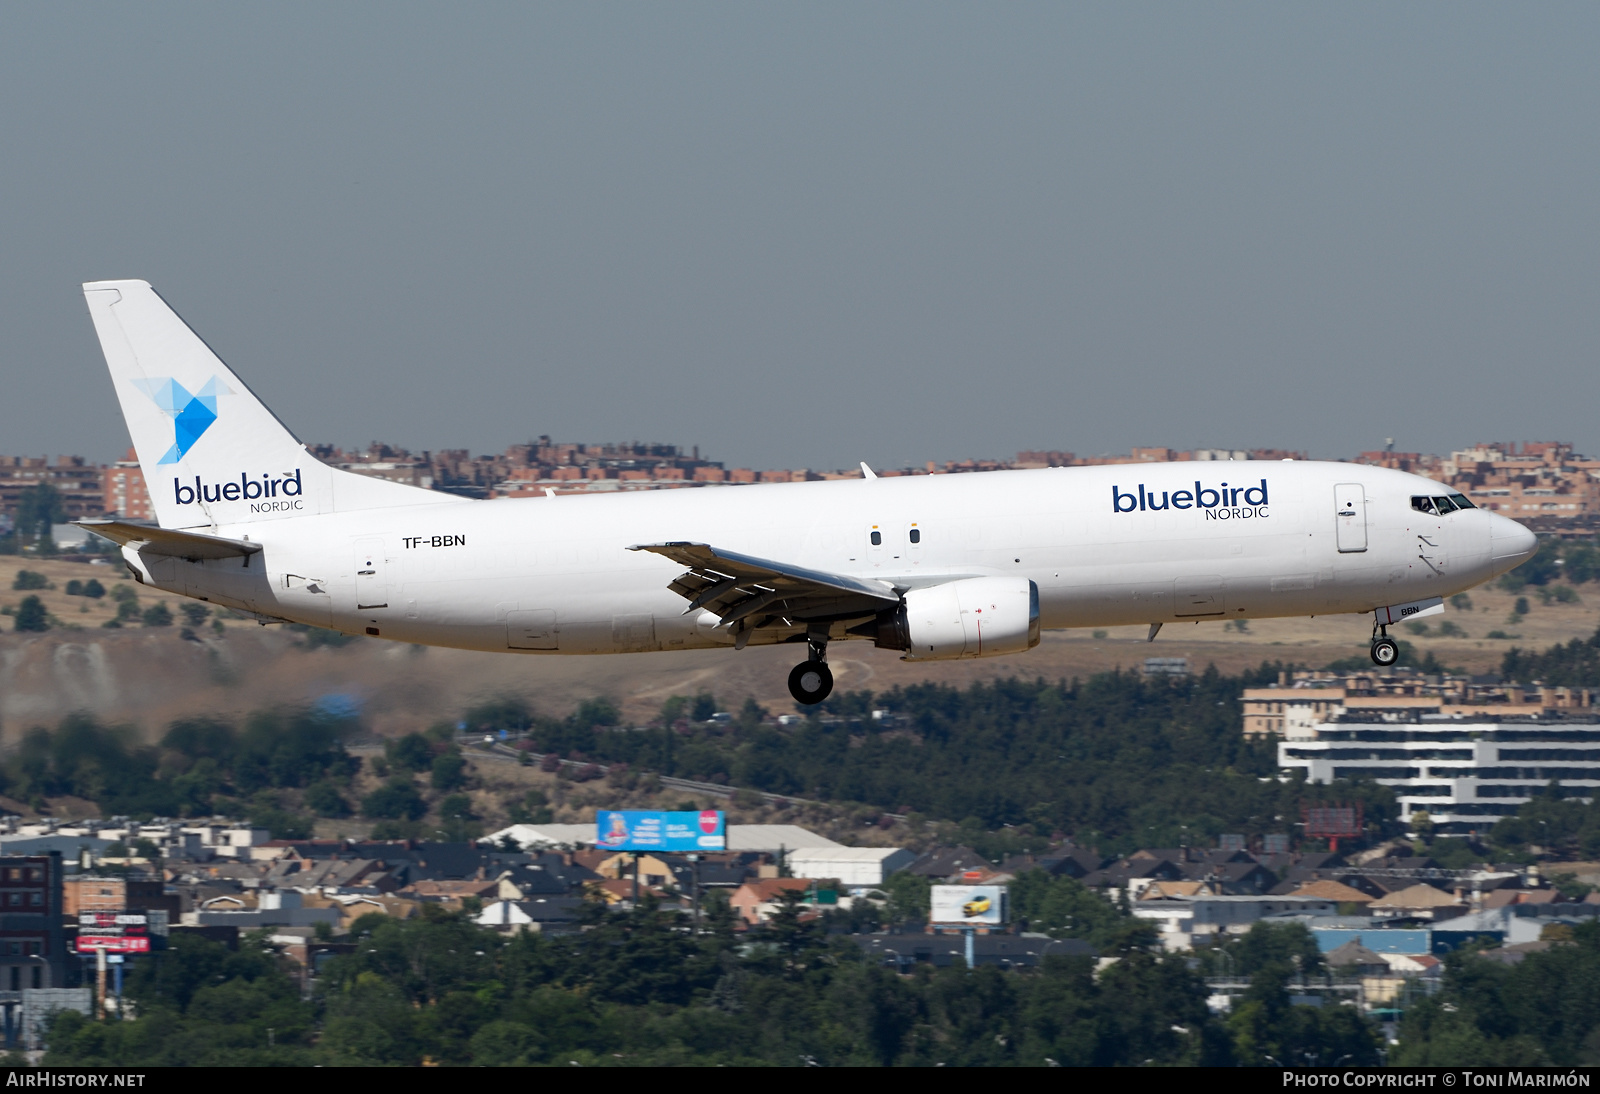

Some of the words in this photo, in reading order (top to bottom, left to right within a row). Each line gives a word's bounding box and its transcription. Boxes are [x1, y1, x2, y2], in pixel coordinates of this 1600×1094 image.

[174, 468, 303, 505] bluebird
[1112, 478, 1269, 513] bluebird
[250, 499, 304, 514] NORDIC
[1205, 507, 1270, 521] NORDIC
[402, 534, 466, 549] TF-BBN
[1400, 605, 1420, 617] BBN
